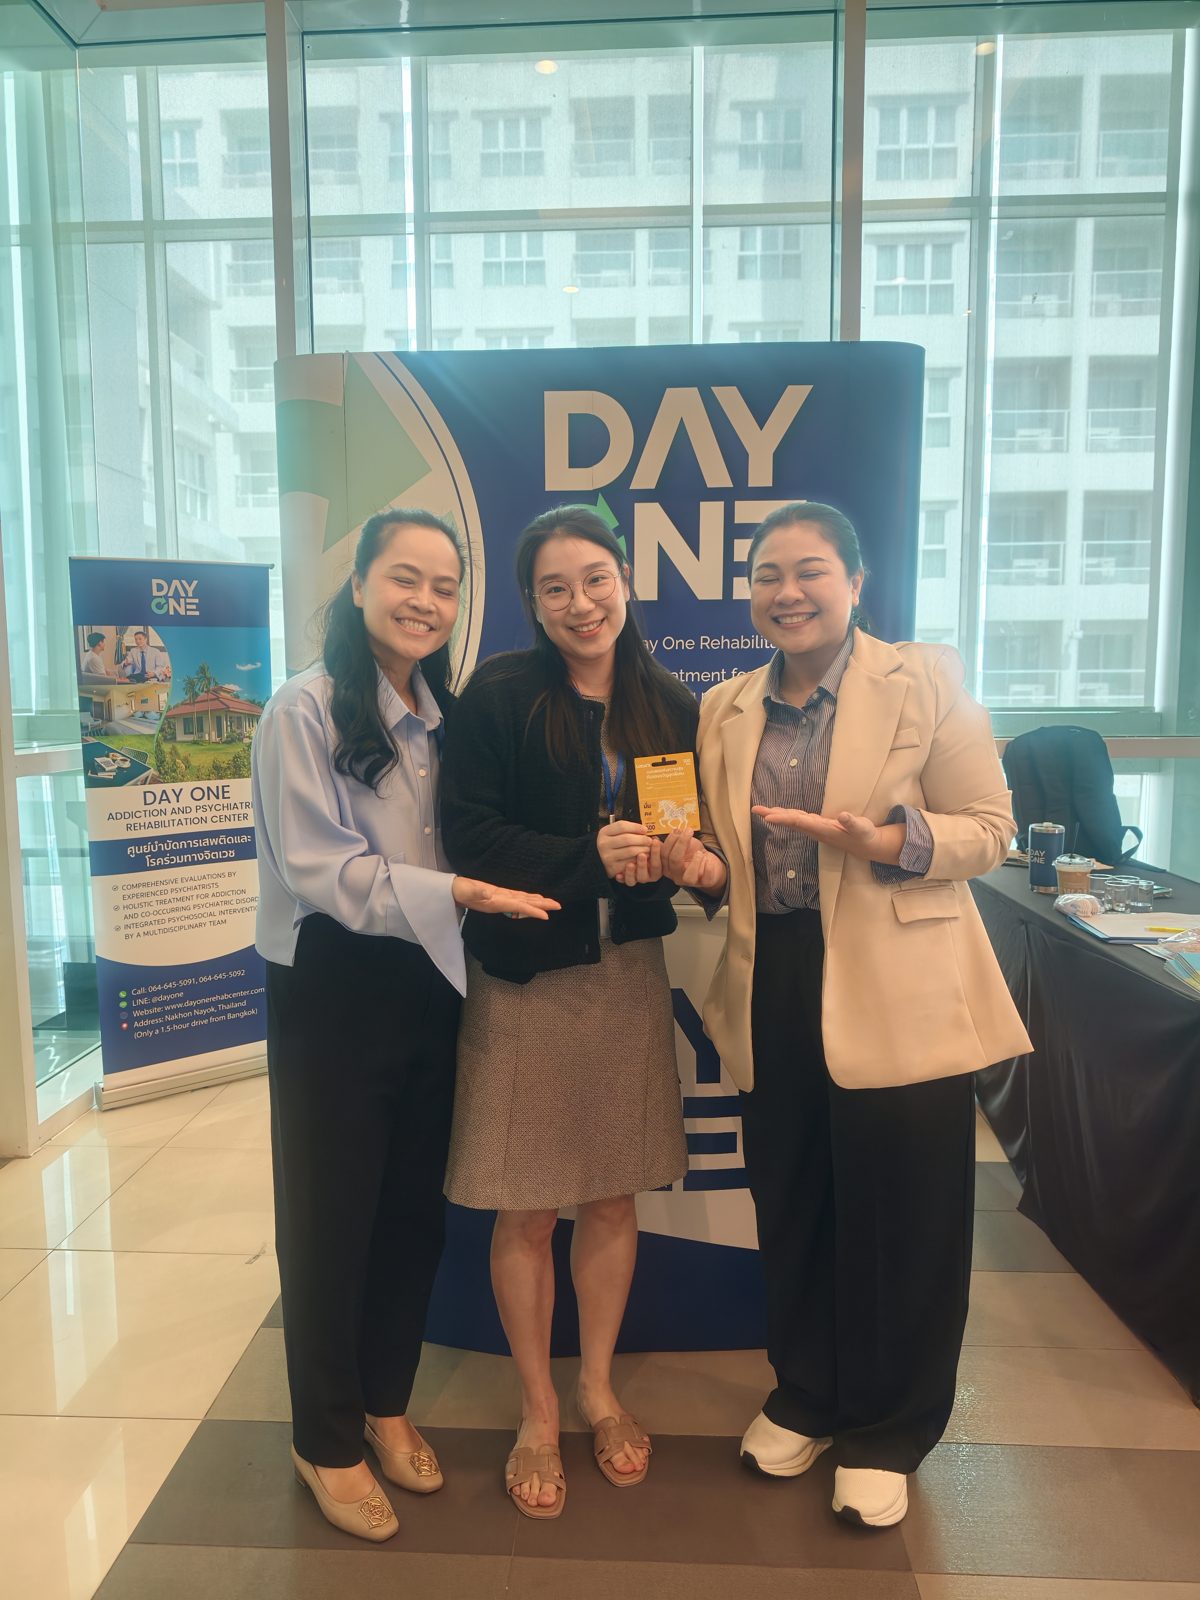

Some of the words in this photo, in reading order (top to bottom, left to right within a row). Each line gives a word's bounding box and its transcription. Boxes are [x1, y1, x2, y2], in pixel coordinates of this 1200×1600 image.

[544, 384, 814, 491] DAY
[151, 578, 198, 597] DAY
[151, 596, 200, 616] ONE
[643, 639, 658, 654] ay
[663, 636, 695, 650] One
[700, 635, 776, 650] Rehabilit
[143, 787, 183, 806] DAY
[190, 784, 231, 801] ONE
[107, 808, 167, 821] ADDICTION
[170, 805, 193, 815] AND
[195, 801, 253, 813] PSYCHIATRI
[126, 816, 208, 832] REHABILITATION
[210, 813, 249, 824] CENTER
[127, 834, 252, 858] ศูนย์บำบัดการเสพติดและ
[145, 849, 235, 867] โรคร่วมทางจิตเวช
[121, 878, 179, 891] COMPREHENSIVE
[180, 872, 226, 884] EVALUATIONS
[122, 889, 169, 901] EXPERIENCED
[170, 882, 220, 893] PSYCHIATRISTS
[122, 900, 154, 911] HOLISTIC
[156, 895, 195, 906] TREATMENT
[196, 893, 210, 901] FOR
[211, 889, 247, 898] ADDICTION
[140, 905, 191, 918] CO-OCCURRING
[193, 899, 234, 911] PSYCHIATRIC
[123, 918, 167, 930] INTEGRATED
[167, 911, 217, 924] PSYCHOSOCIAL
[124, 932, 134, 940] BY
[143, 922, 207, 937] MULTIDISCIPLINARY
[209, 919, 227, 927] TEAM
[131, 987, 147, 996] Call:
[198, 969, 246, 983] 064-645-5092
[132, 998, 151, 1007] LINE:
[151, 991, 184, 1003] @dayone
[132, 1006, 164, 1017] Website:
[164, 986, 265, 1011] www.dayonerehabcenter.com
[133, 1016, 164, 1028] Address:
[164, 1010, 193, 1022] Nakhon
[193, 1005, 217, 1017] Nayok,
[218, 1000, 247, 1011] Thailand
[133, 1028, 153, 1040] (Only
[160, 1022, 191, 1033] 1.5-hour
[191, 1018, 209, 1028] drive
[209, 1014, 226, 1024] from
[227, 1008, 258, 1021] Bangkok)
